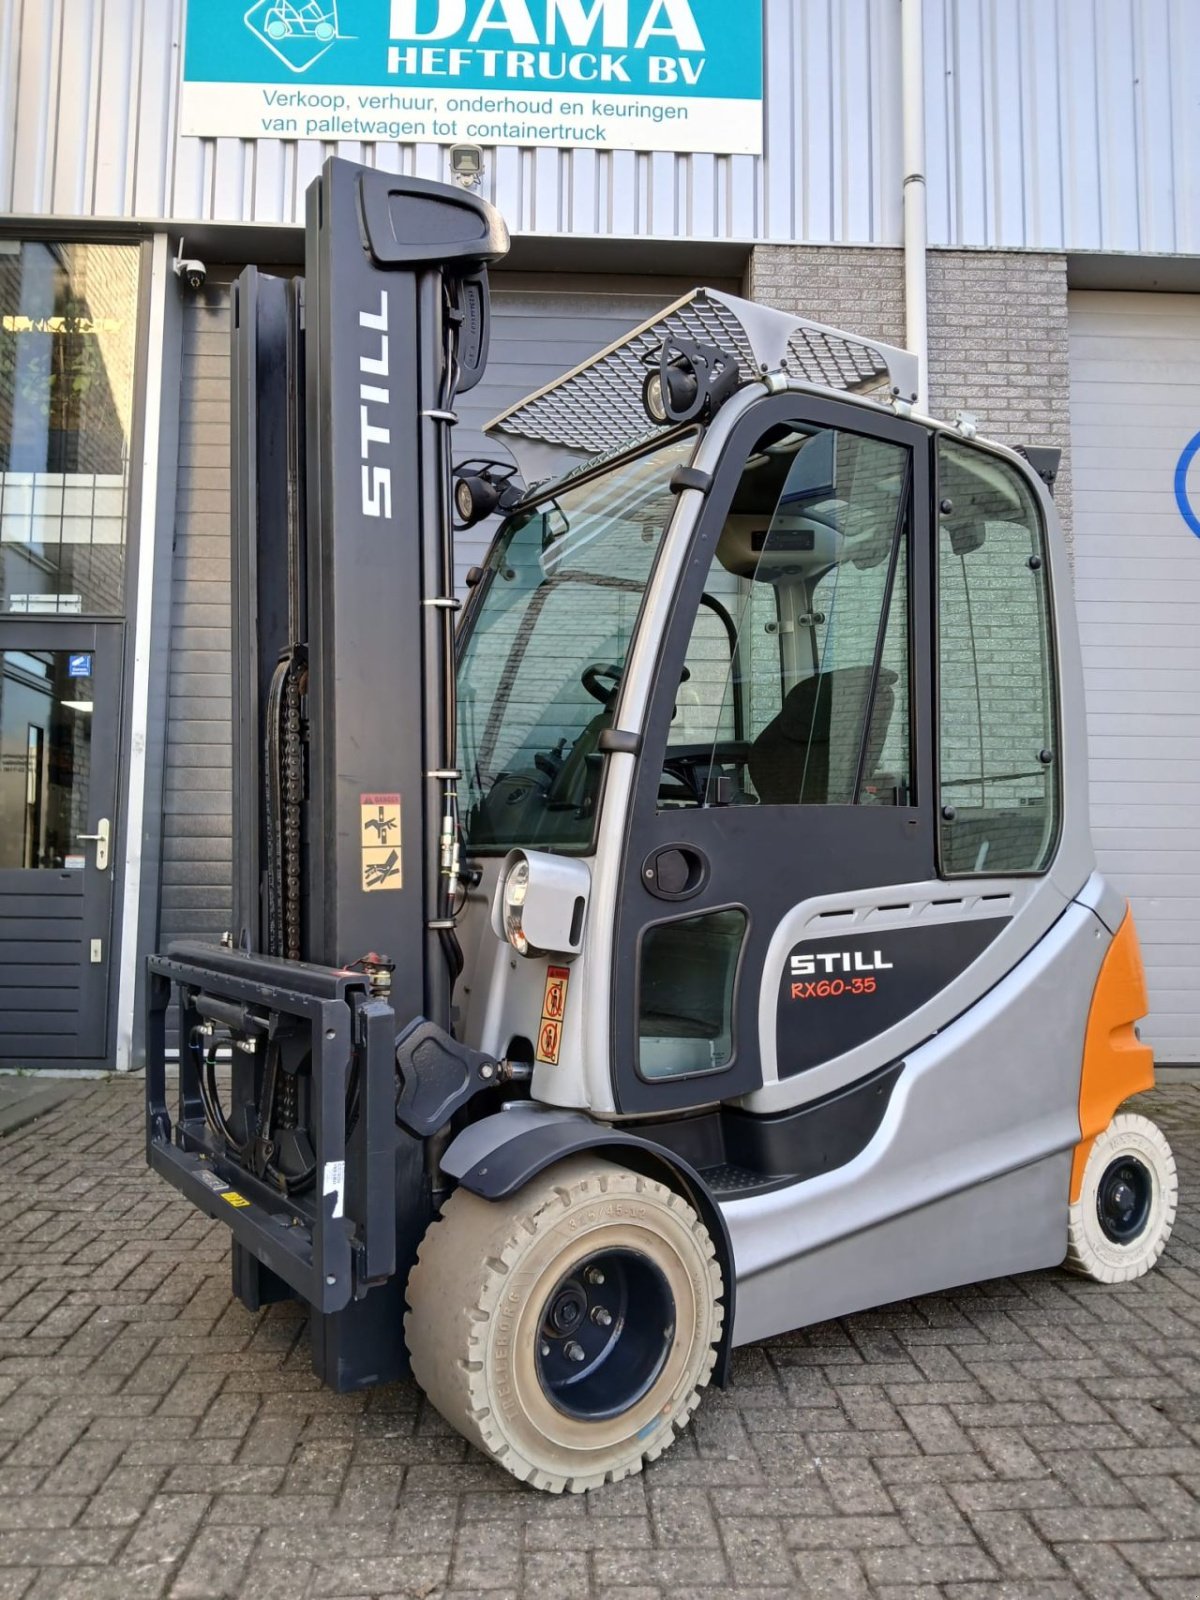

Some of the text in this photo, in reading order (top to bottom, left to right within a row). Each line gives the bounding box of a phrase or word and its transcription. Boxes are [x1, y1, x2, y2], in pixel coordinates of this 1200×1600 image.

[388, 0, 706, 51] DAMA
[387, 46, 706, 85] HEFTRUCK BV
[262, 89, 688, 122] Verkoop, verhuur, onderhoud en keuringen
[261, 116, 607, 141] van palletwagen tot containertruck
[359, 289, 392, 519] STILL
[790, 950, 893, 975] STILL
[791, 977, 877, 999] RX60-35
